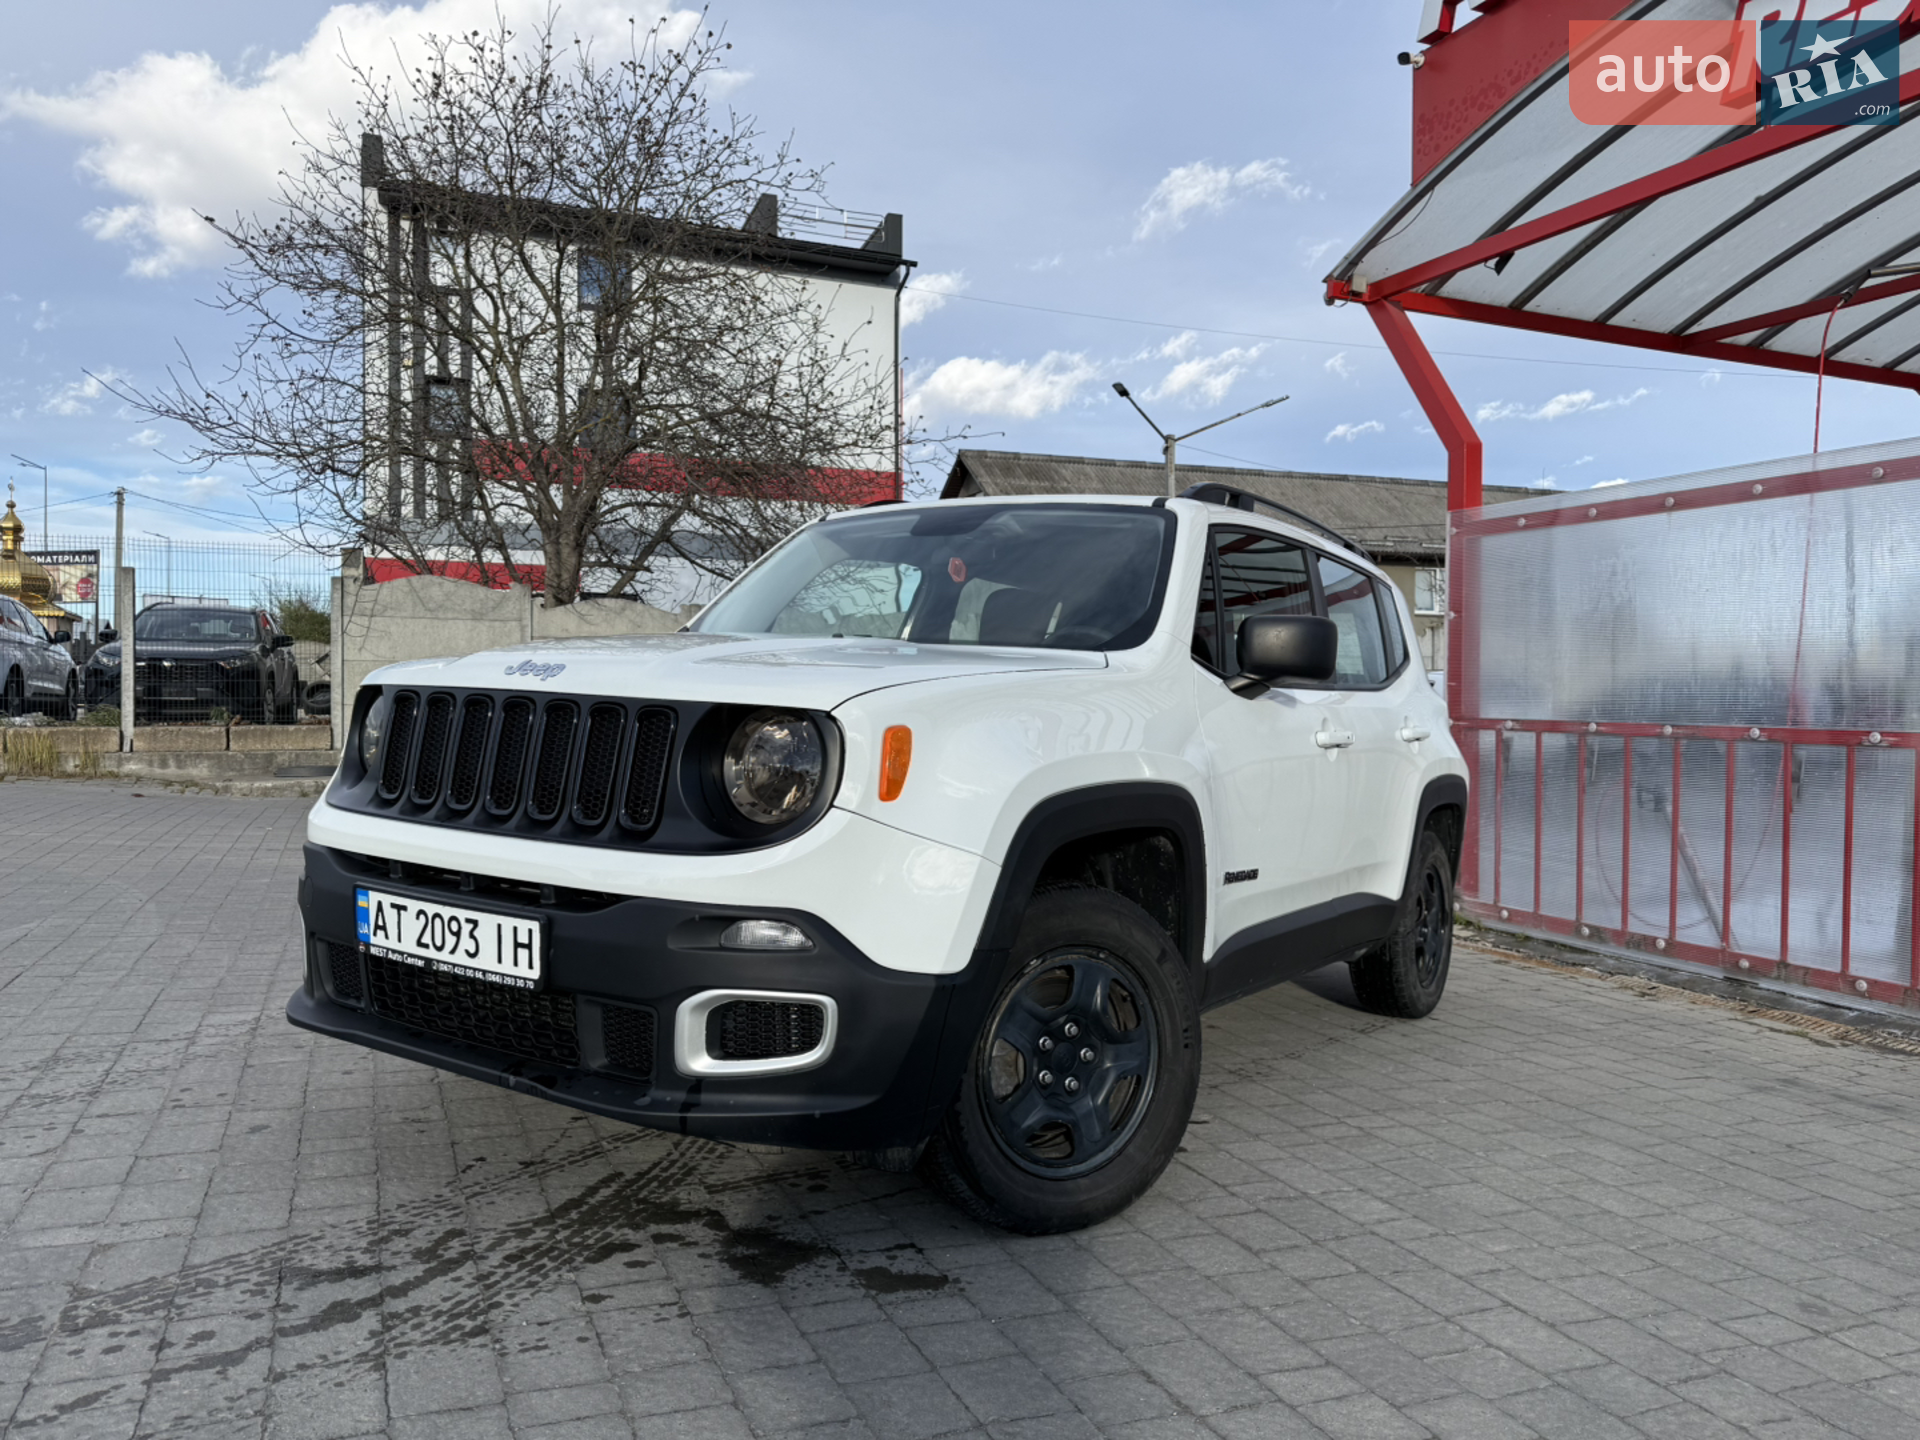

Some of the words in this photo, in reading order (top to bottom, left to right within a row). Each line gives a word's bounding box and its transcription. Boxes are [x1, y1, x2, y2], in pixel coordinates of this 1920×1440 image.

[504, 659, 566, 681] Jeep
[358, 921, 369, 935] UA
[372, 899, 408, 944] AT
[415, 908, 480, 959] 2093
[497, 923, 534, 970] IH
[370, 945, 387, 958] WEST
[387, 950, 403, 962] Auto
[403, 954, 425, 967] Center
